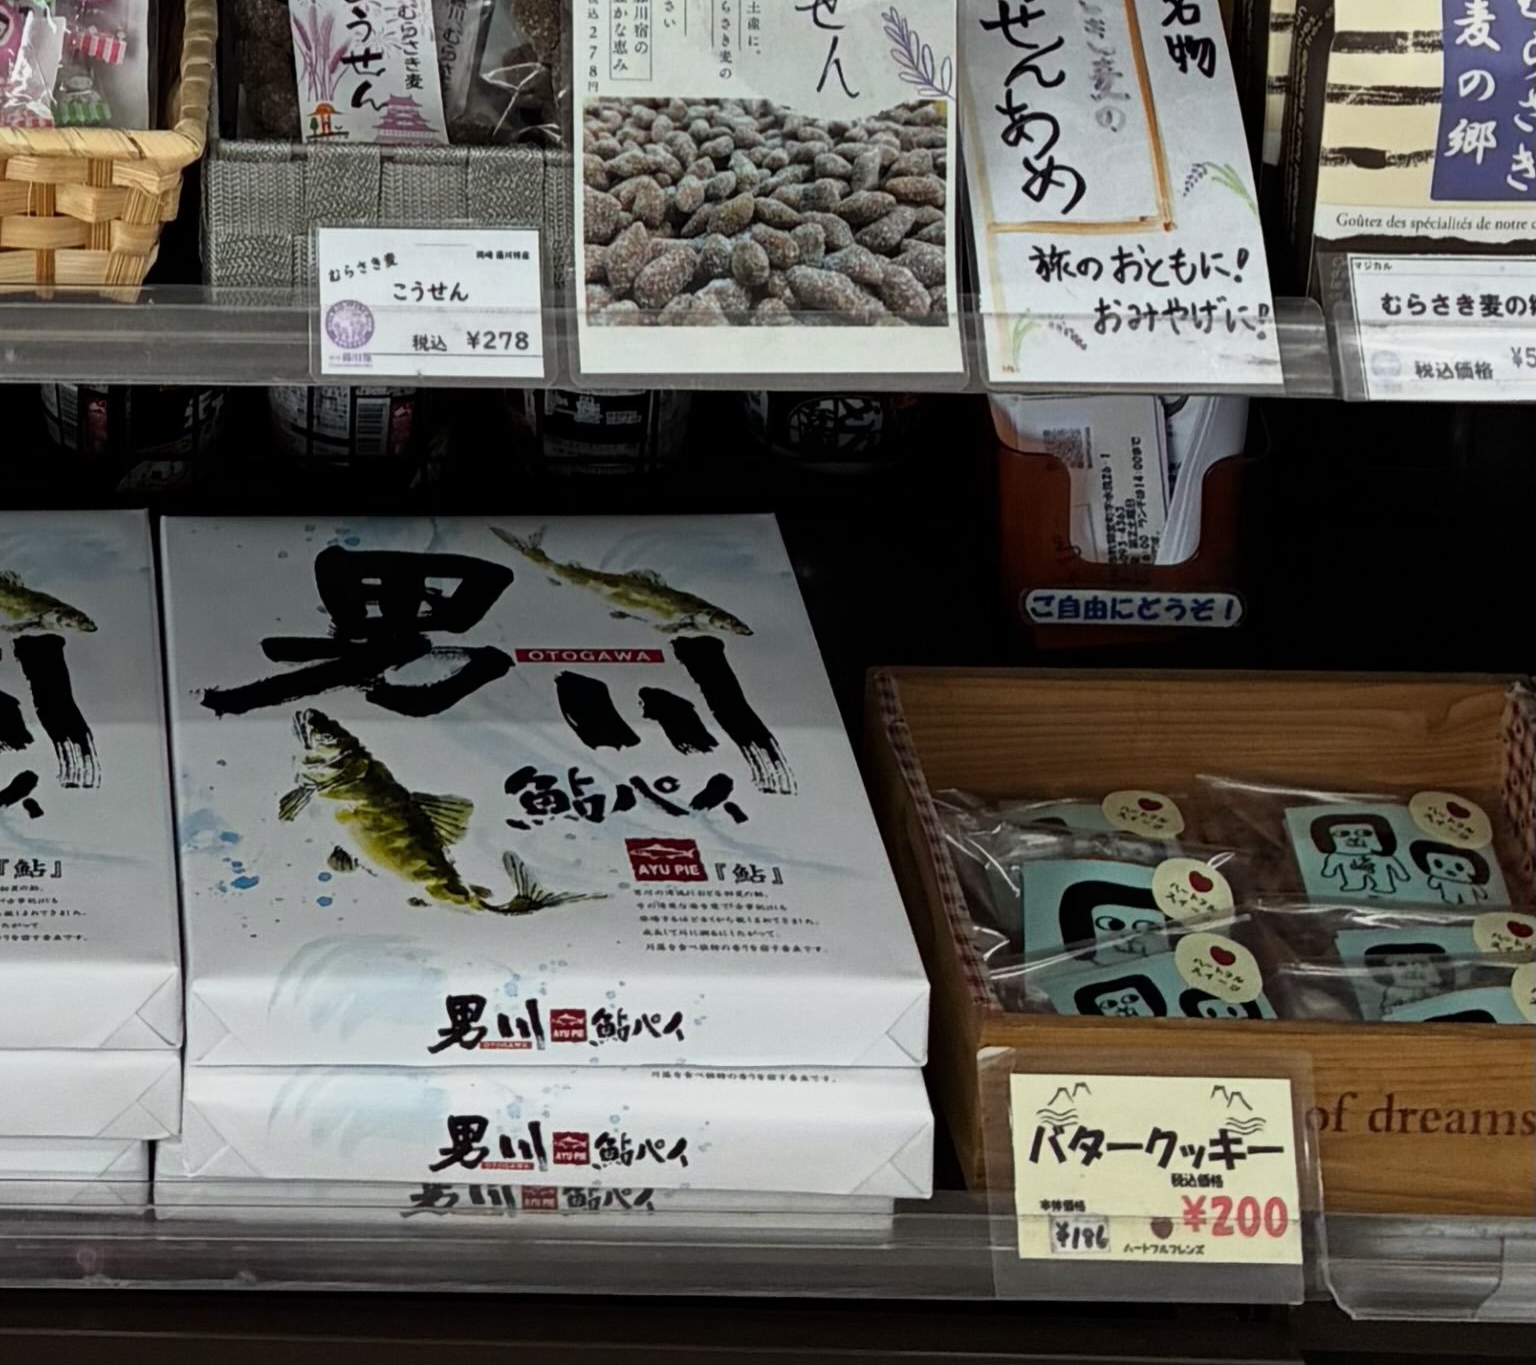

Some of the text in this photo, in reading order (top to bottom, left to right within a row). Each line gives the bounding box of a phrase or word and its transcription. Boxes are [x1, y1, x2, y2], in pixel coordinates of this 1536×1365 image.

[1336, 211, 1528, 234] Goûtez des spécialités de notre
[328, 251, 399, 283] むらさき麦
[1027, 245, 1251, 287] 旅のおともに!
[392, 281, 470, 303] こうせん
[412, 330, 530, 353] 税込 ¥278
[1413, 359, 1495, 383] 税込価格
[1029, 593, 1236, 621] ご自由にどうぞ!
[188, 545, 800, 797] 男川
[527, 648, 652, 662] OTOGAWA
[503, 764, 750, 832] 鮎パイ
[638, 863, 702, 878] AYU PIE
[427, 994, 686, 1055] 男川 鮎パイ
[1307, 1091, 1357, 1134] of
[428, 1114, 690, 1174] 男川 鮎パイ
[1029, 1124, 1284, 1170] バタークッキー
[1170, 1172, 1224, 1188] 税込価格
[1181, 1194, 1290, 1239] ¥200
